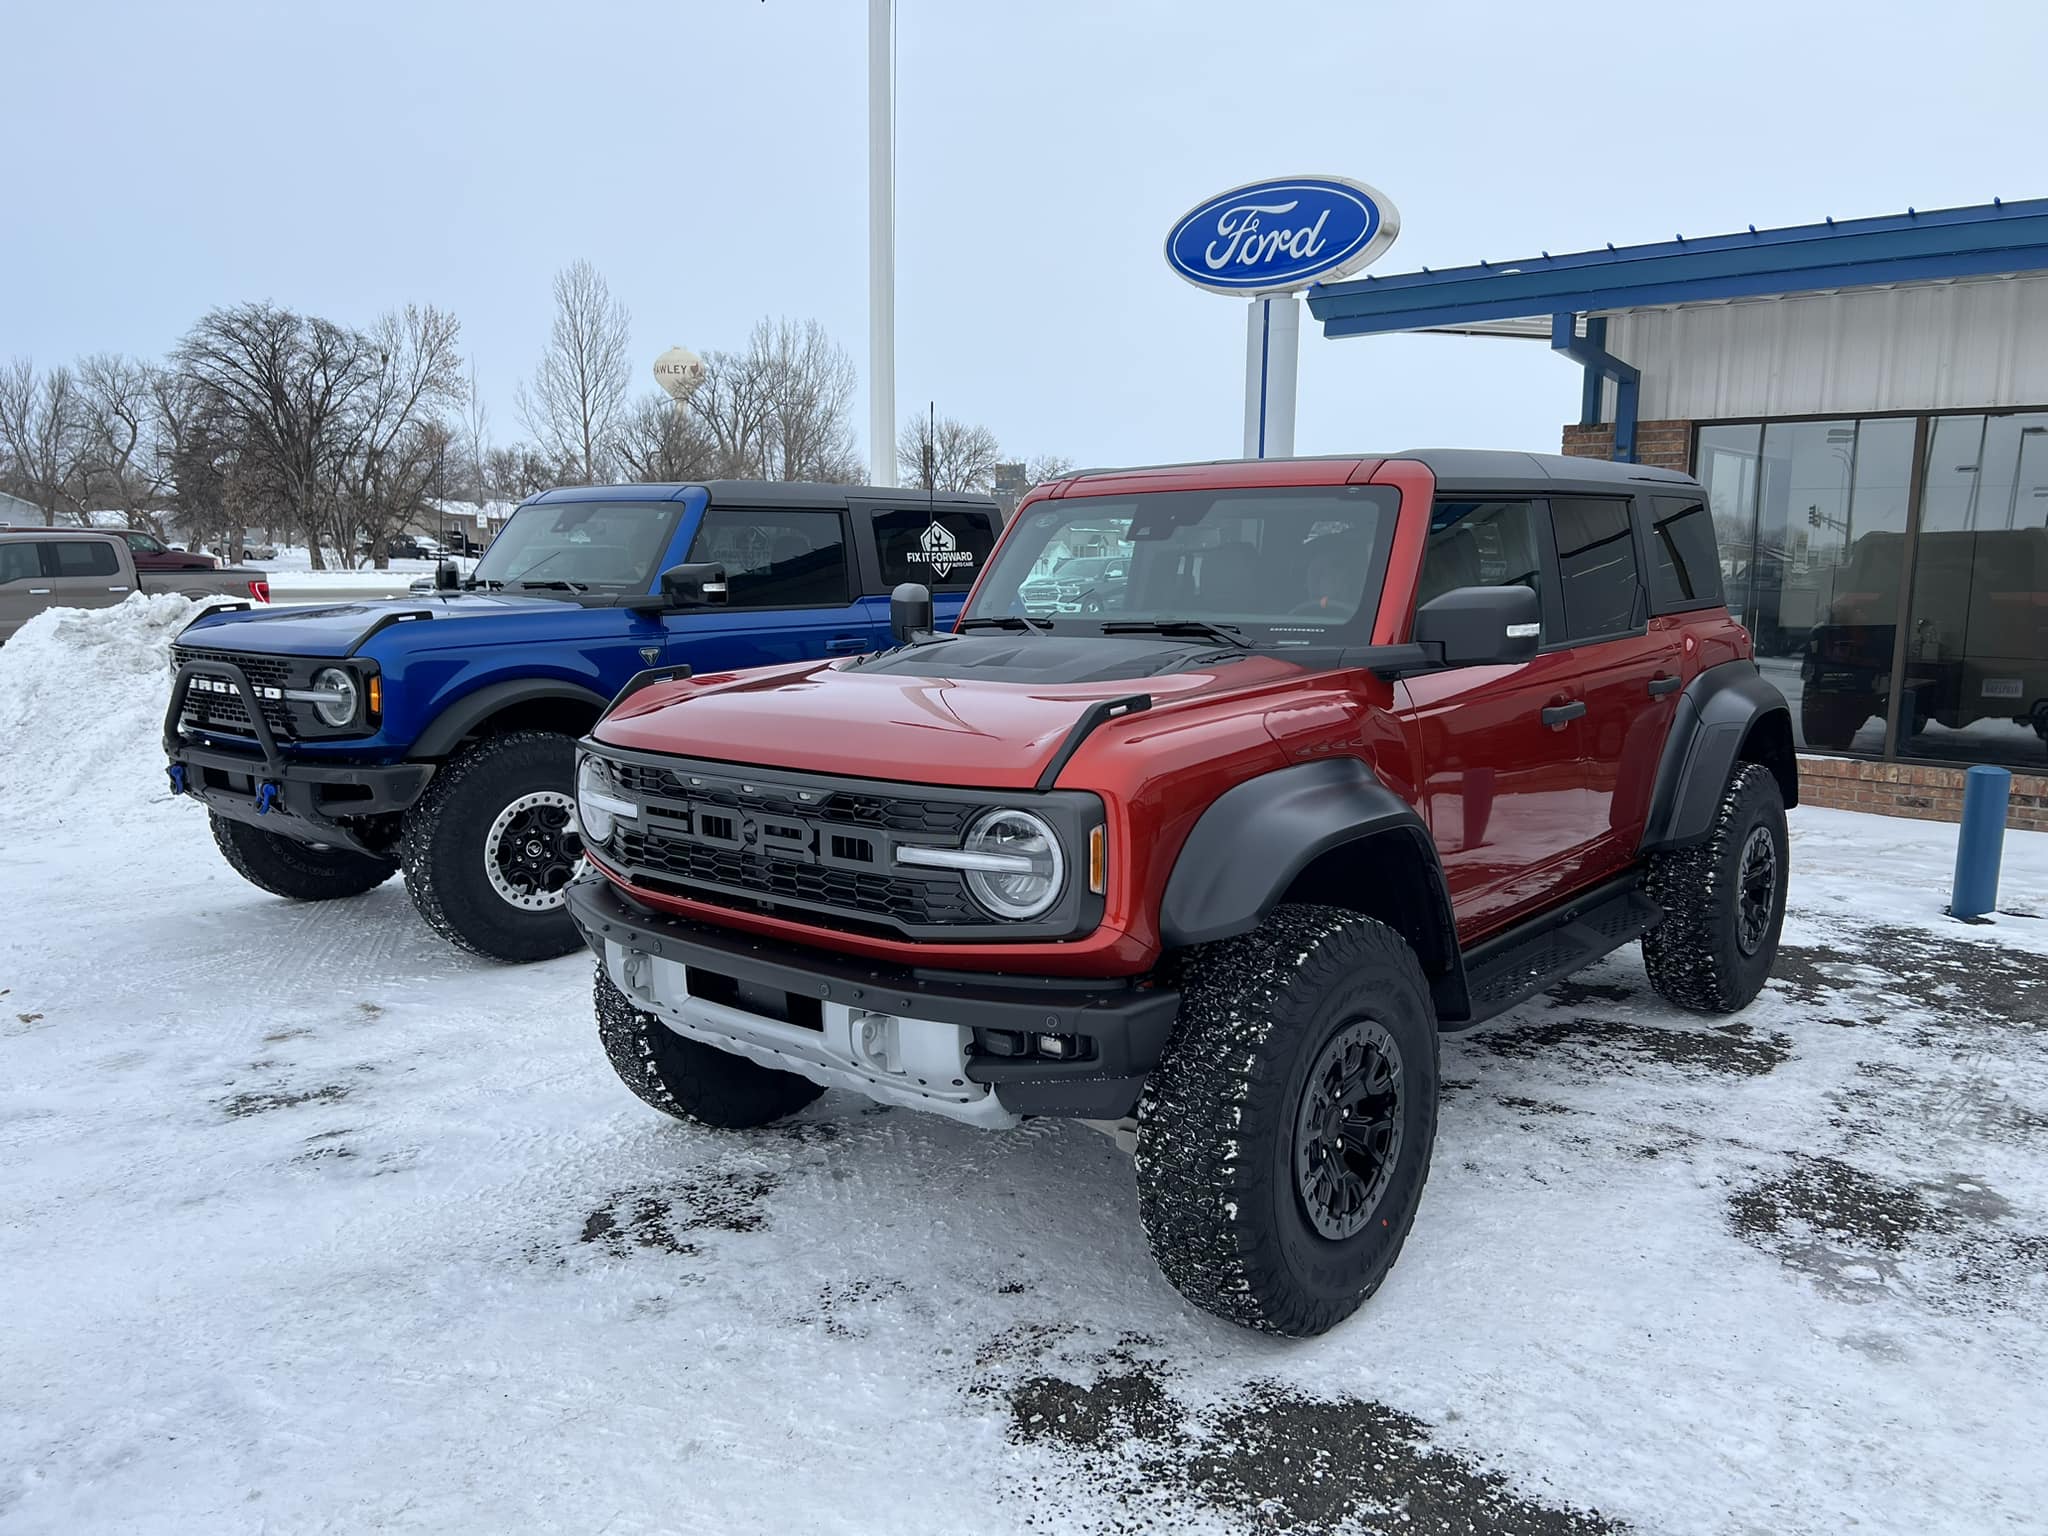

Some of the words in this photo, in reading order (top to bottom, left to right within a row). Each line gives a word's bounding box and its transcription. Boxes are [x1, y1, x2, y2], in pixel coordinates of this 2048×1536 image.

[1205, 200, 1331, 270] Ford
[906, 552, 921, 562] FIX
[922, 552, 930, 562] IT
[931, 551, 973, 562] FORWARD
[638, 794, 888, 876] FORD
